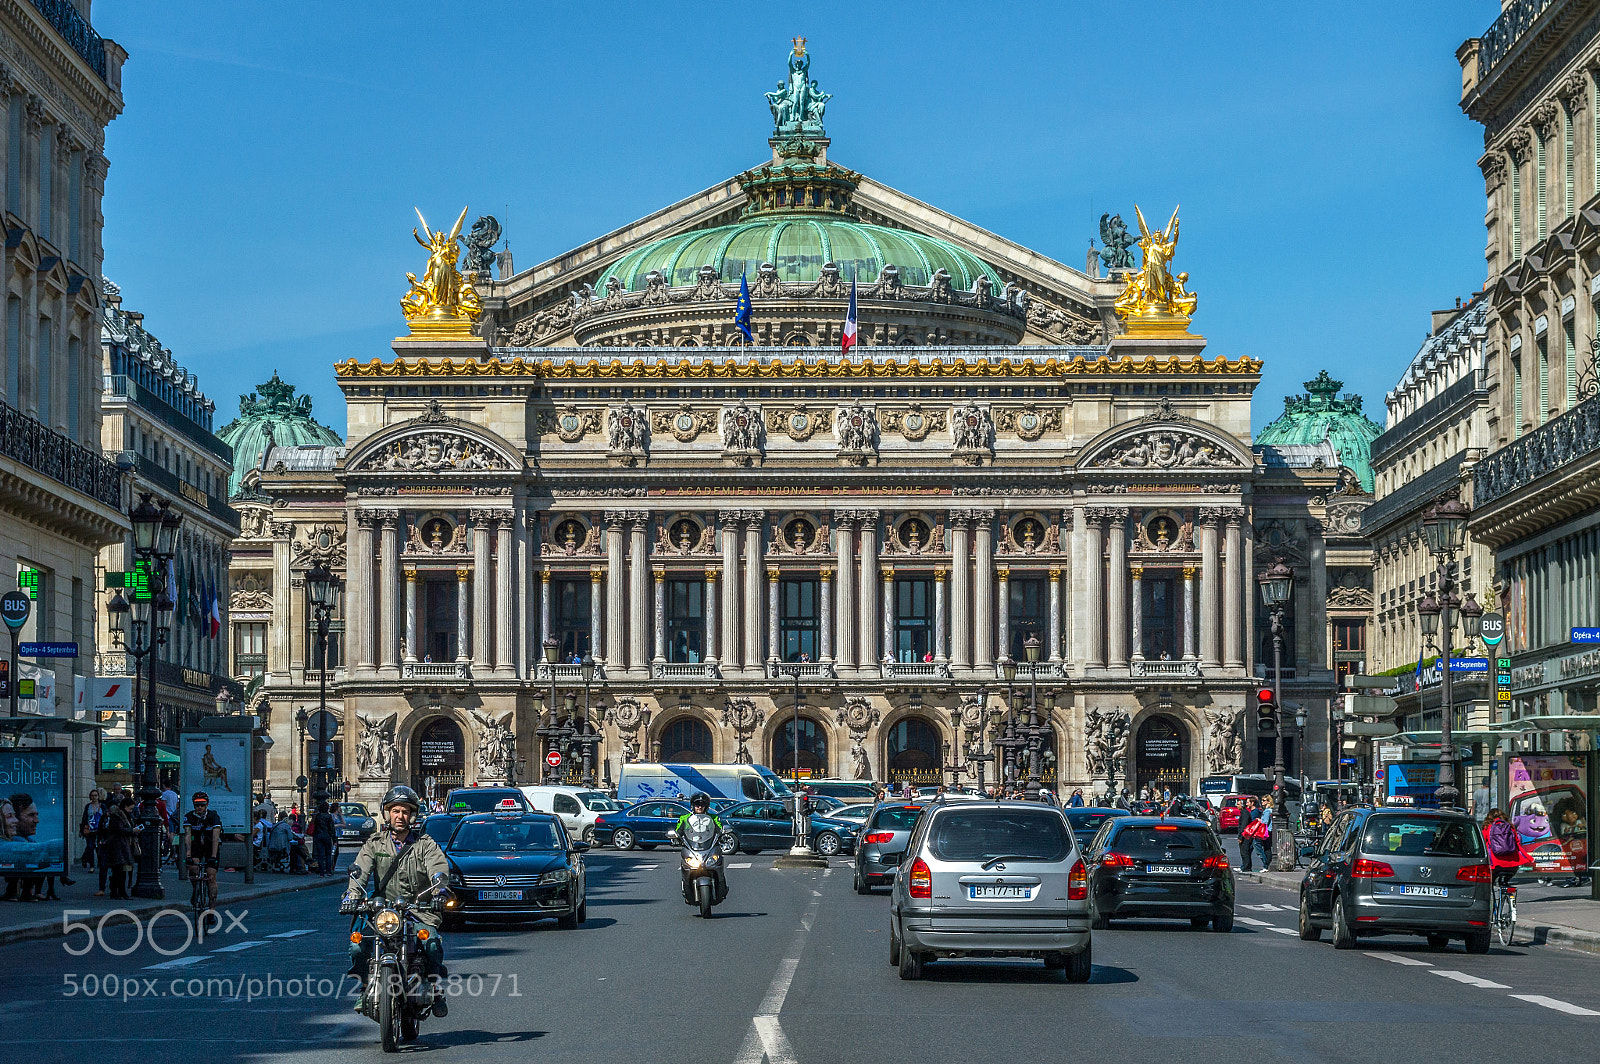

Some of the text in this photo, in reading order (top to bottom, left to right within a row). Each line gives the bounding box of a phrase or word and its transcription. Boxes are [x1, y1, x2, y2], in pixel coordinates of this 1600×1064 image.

[677, 485, 922, 495] ACADEMIE NATIONALE DE MUSIQUE
[4, 600, 26, 611] BUS
[1482, 620, 1502, 631] BUS
[1573, 632, 1591, 640] Opéra
[47, 646, 76, 654] Septembre
[1460, 661, 1487, 669] Septembre
[1500, 659, 1509, 667] 21
[1499, 692, 1509, 700] 68
[14, 758, 33, 770] EN
[976, 885, 1022, 896] BY-177-TF
[483, 891, 518, 900] BF-904-SR
